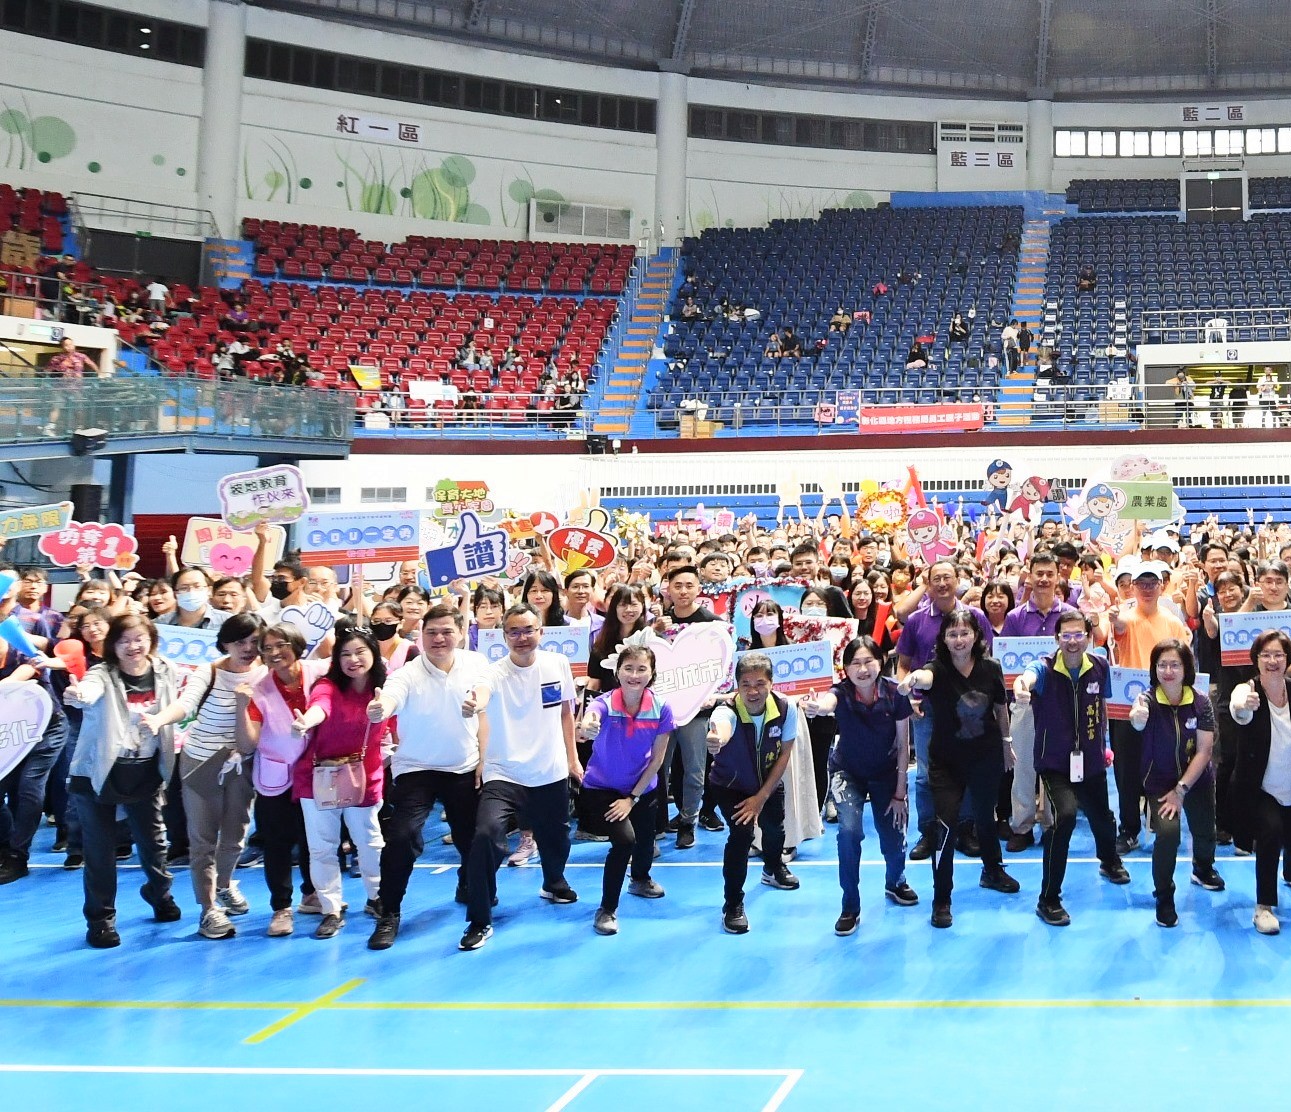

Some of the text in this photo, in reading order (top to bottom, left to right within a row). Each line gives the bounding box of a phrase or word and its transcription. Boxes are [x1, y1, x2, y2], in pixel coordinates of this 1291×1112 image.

[1183, 105, 1243, 122] 藍二區
[336, 114, 420, 142] 紅一區
[950, 151, 1013, 168] 藍三區
[434, 488, 487, 502] 保育大地
[1131, 495, 1168, 508] 農業處
[2, 510, 60, 534] 力無限
[564, 531, 605, 558] 優秀
[462, 539, 497, 572] 讚
